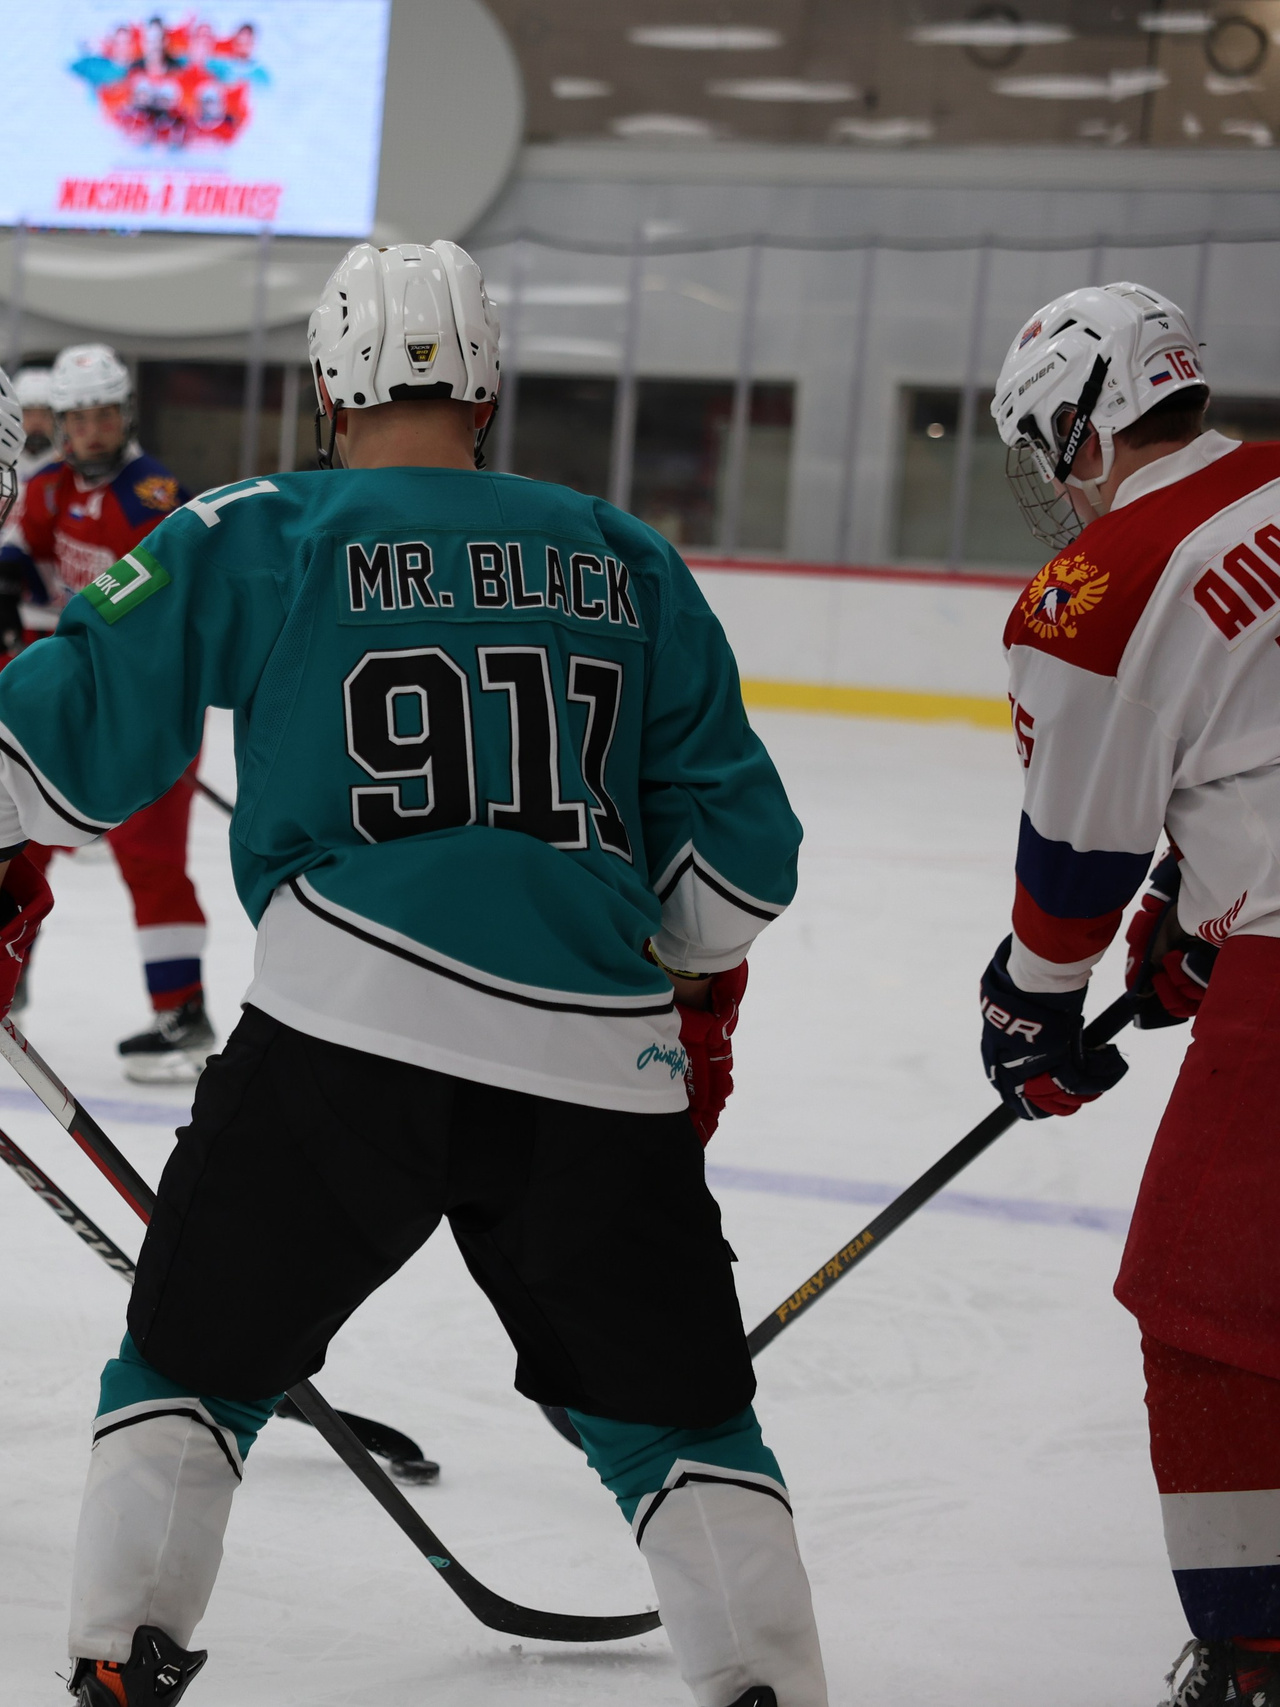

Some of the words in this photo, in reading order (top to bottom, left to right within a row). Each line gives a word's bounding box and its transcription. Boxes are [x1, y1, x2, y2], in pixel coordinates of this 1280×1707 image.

[1018, 361, 1056, 396] BAUER
[1164, 350, 1197, 381] 16
[1063, 418, 1087, 465] SOYUZ
[346, 541, 454, 612] MR.
[467, 542, 639, 629] BLACK
[342, 646, 634, 865] 911
[775, 1269, 825, 1324] FURY
[840, 1230, 875, 1263] TEAM
